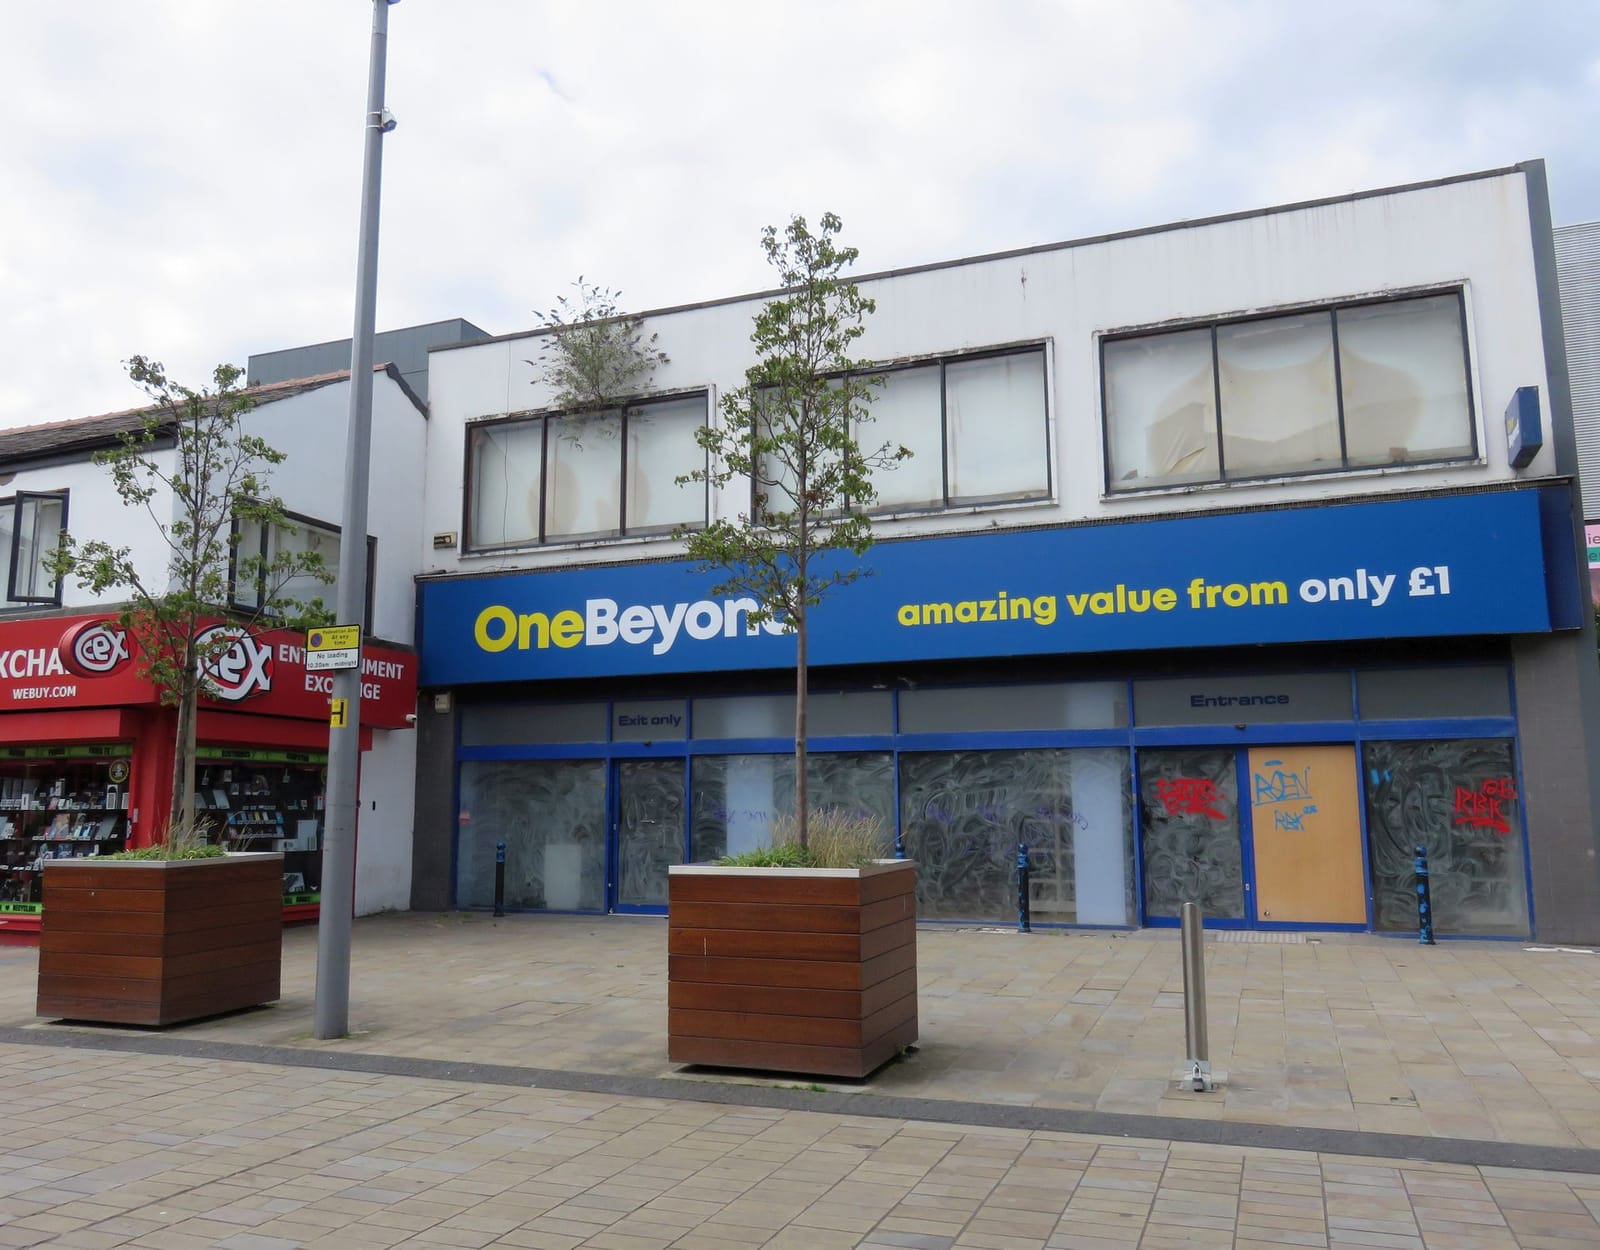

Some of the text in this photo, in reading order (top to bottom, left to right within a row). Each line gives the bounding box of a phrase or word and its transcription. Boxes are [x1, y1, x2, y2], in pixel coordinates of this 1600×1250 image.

[898, 566, 1451, 626] amazing value from only £1
[12, 685, 77, 700] WEBUY.COM
[1190, 694, 1290, 708] Entrance
[618, 713, 682, 727] Exit only
